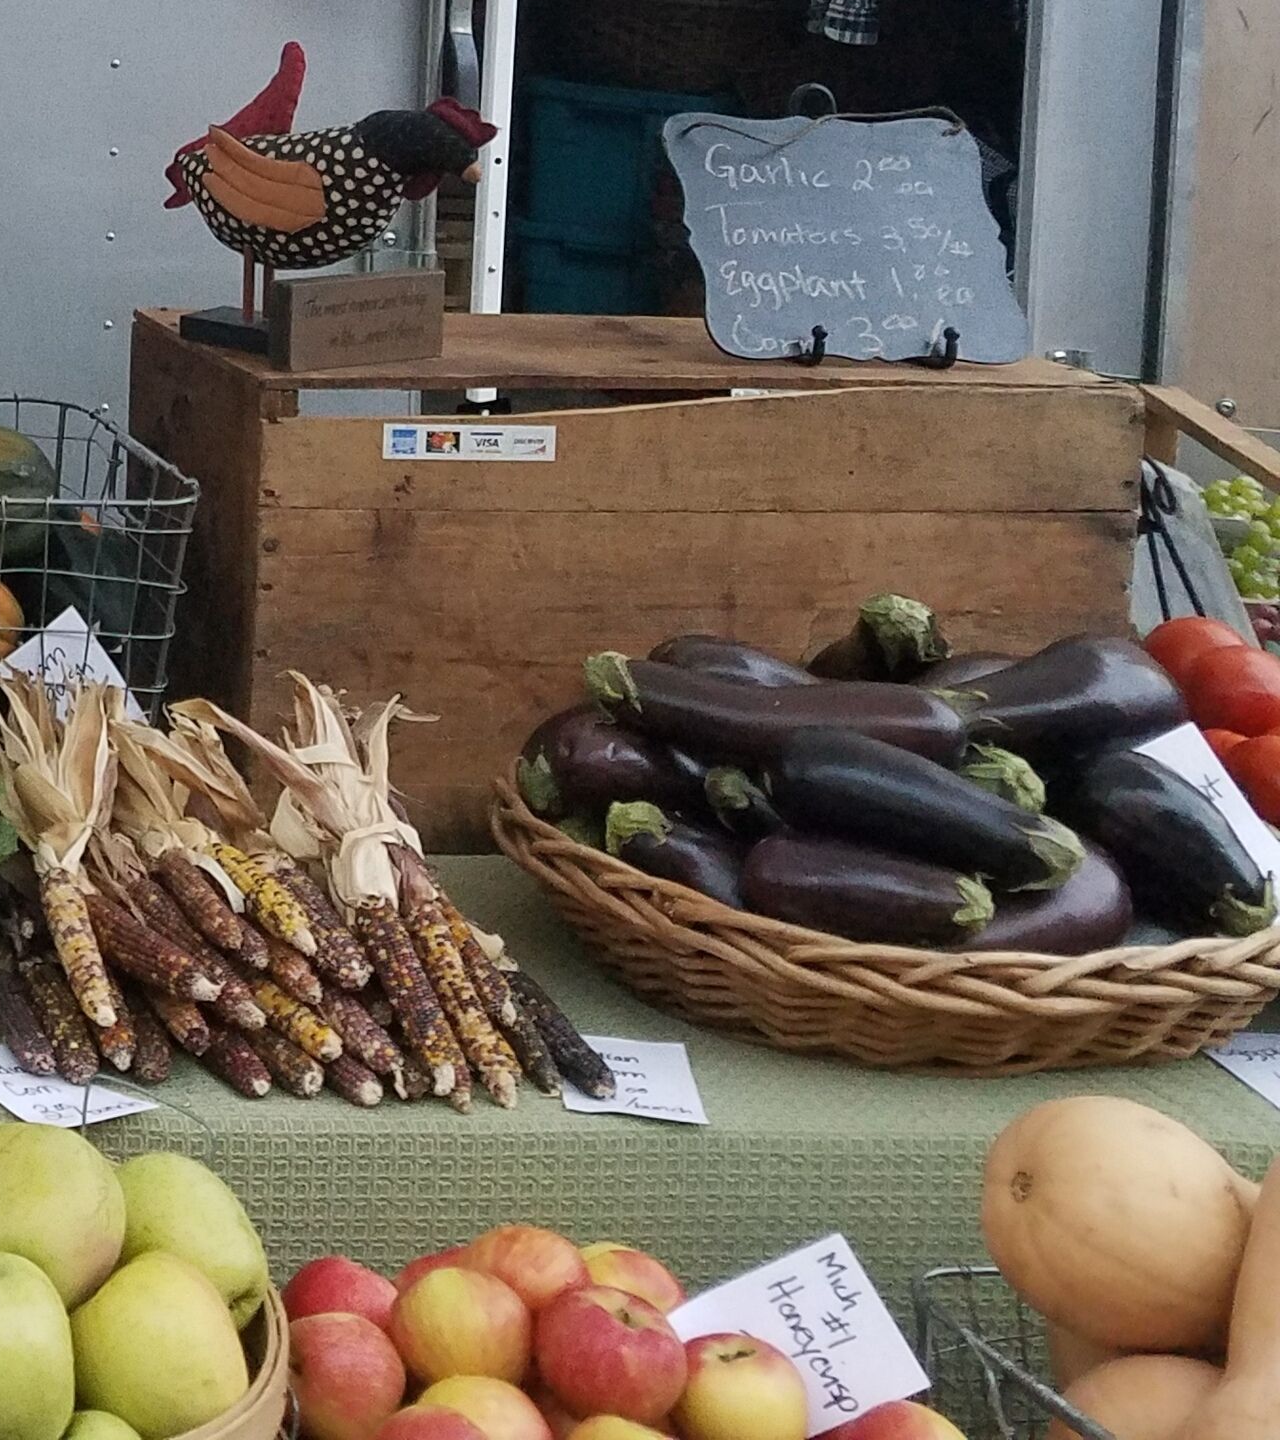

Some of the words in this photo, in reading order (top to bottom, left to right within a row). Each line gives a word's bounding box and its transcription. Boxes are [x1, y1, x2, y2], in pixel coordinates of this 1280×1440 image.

[705, 143, 831, 190] Garlic
[705, 200, 862, 247] Tomatoes
[720, 260, 867, 311] Eggplant
[732, 315, 814, 355] Corn
[474, 438, 500, 448] VISA
[817, 1252, 862, 1311] Mich
[768, 1276, 859, 1413] Honeycrisp
